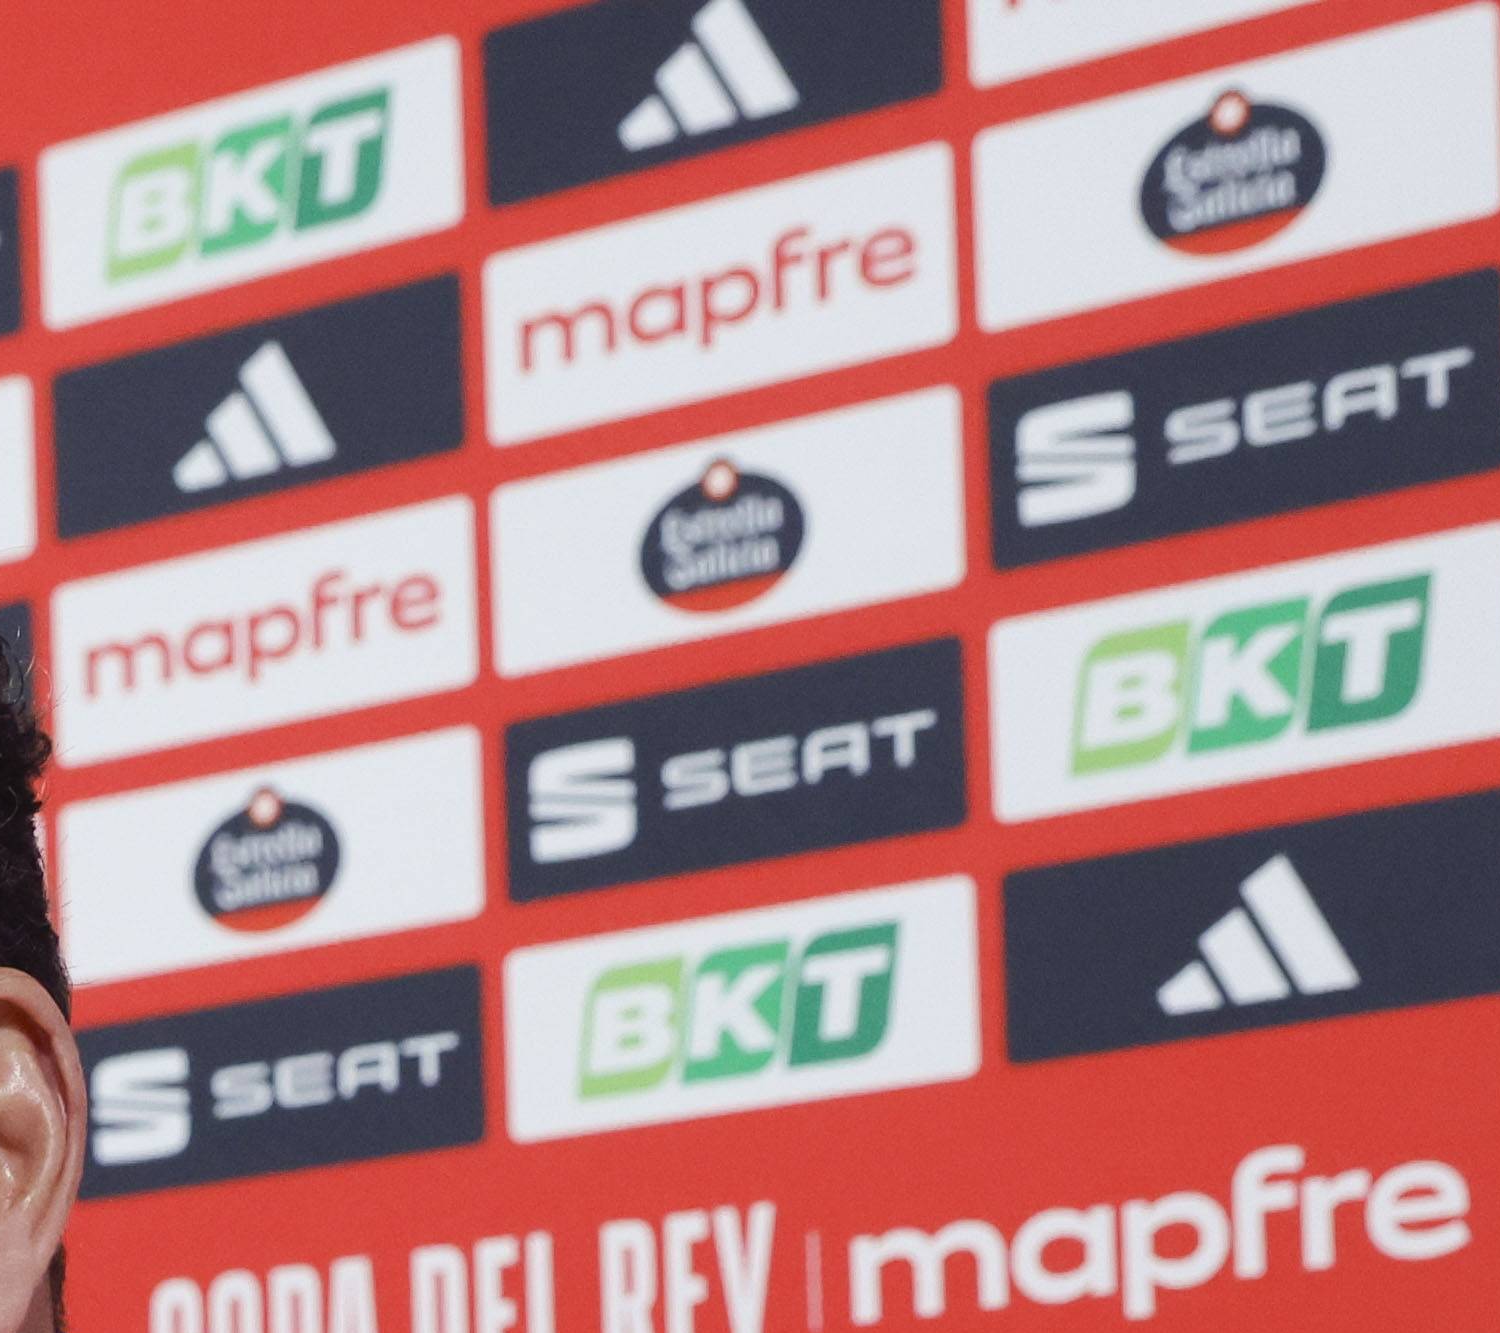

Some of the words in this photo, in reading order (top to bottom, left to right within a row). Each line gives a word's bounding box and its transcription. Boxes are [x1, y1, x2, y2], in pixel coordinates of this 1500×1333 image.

[106, 92, 388, 280] BKT
[519, 224, 918, 373] mapfre
[1166, 349, 1472, 463] SEAT
[85, 572, 442, 700] mapfre
[1075, 580, 1428, 770] BKT
[662, 712, 935, 808] SEAT
[213, 1034, 458, 1117] SEAT
[581, 927, 895, 1096] BKT
[850, 1146, 1469, 1322] mapfre
